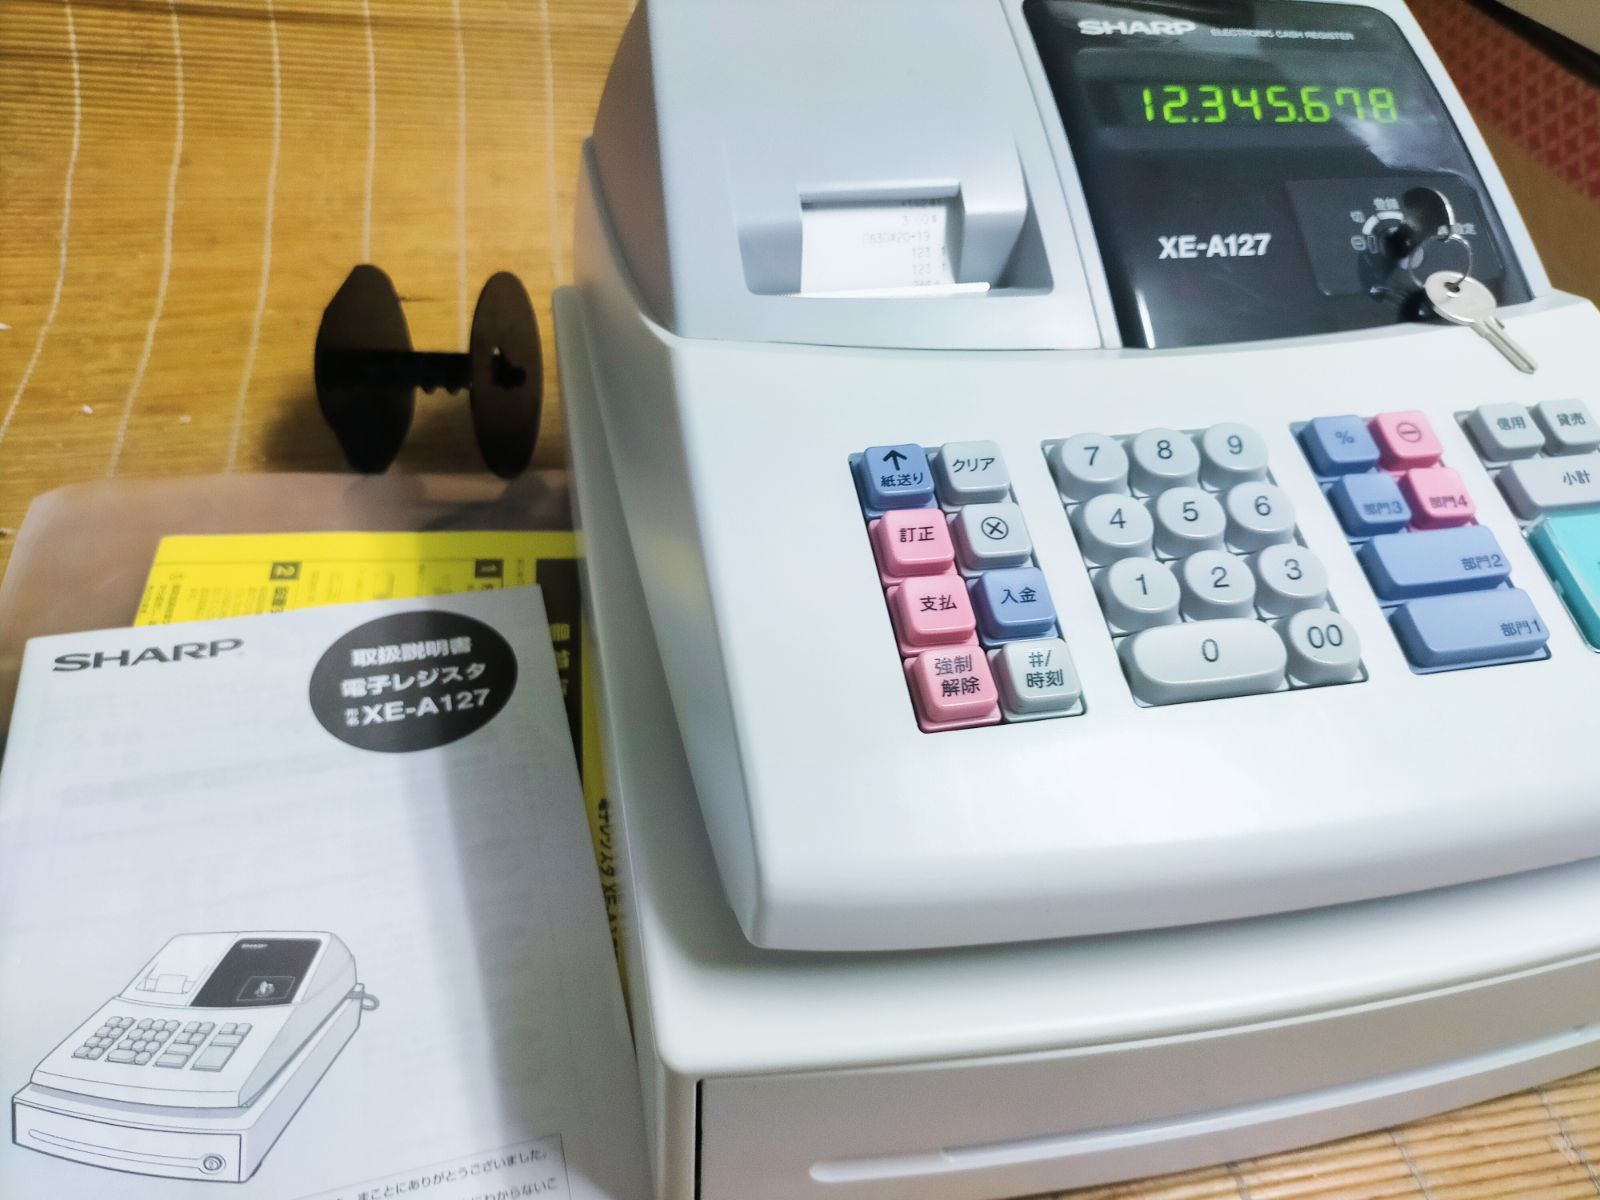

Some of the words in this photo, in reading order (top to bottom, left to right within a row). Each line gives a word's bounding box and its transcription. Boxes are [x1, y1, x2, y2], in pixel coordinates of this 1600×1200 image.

[1078, 20, 1197, 36] SHARP
[1210, 29, 1274, 38] ELECTRONIC
[1275, 30, 1303, 39] CASH
[1304, 30, 1354, 40] REGISTER
[1158, 233, 1272, 259] XE-A127
[1497, 416, 1526, 431] 信用
[1157, 440, 1173, 459] 8
[1227, 435, 1243, 455] 9
[952, 457, 995, 472] クリア
[1083, 446, 1099, 466] 7
[880, 472, 923, 487] 紙送り
[1562, 470, 1591, 484] 小計
[1182, 501, 1199, 522] 5
[1255, 495, 1271, 516] 6
[1364, 501, 1402, 515] 部門3
[1429, 495, 1468, 508] 部門4
[1109, 508, 1126, 529] 4
[898, 526, 934, 543] 訂正
[1284, 559, 1302, 580] 3
[1460, 555, 1503, 571] 部門2
[1135, 574, 1148, 595] 1
[1211, 566, 1230, 588] 2
[920, 594, 957, 612] 支払
[1001, 587, 1036, 604] 入金
[1307, 624, 1343, 648] 00
[1500, 620, 1541, 637] 部門1
[53, 638, 244, 671] SHARP
[352, 636, 472, 667] 取扱説明書
[1201, 638, 1219, 662] 0
[935, 654, 972, 675] 強制
[340, 663, 485, 698] 電子レジスタ
[941, 677, 980, 697] 解除
[1026, 669, 1063, 689] 時刻
[362, 688, 490, 725] XE-A127
